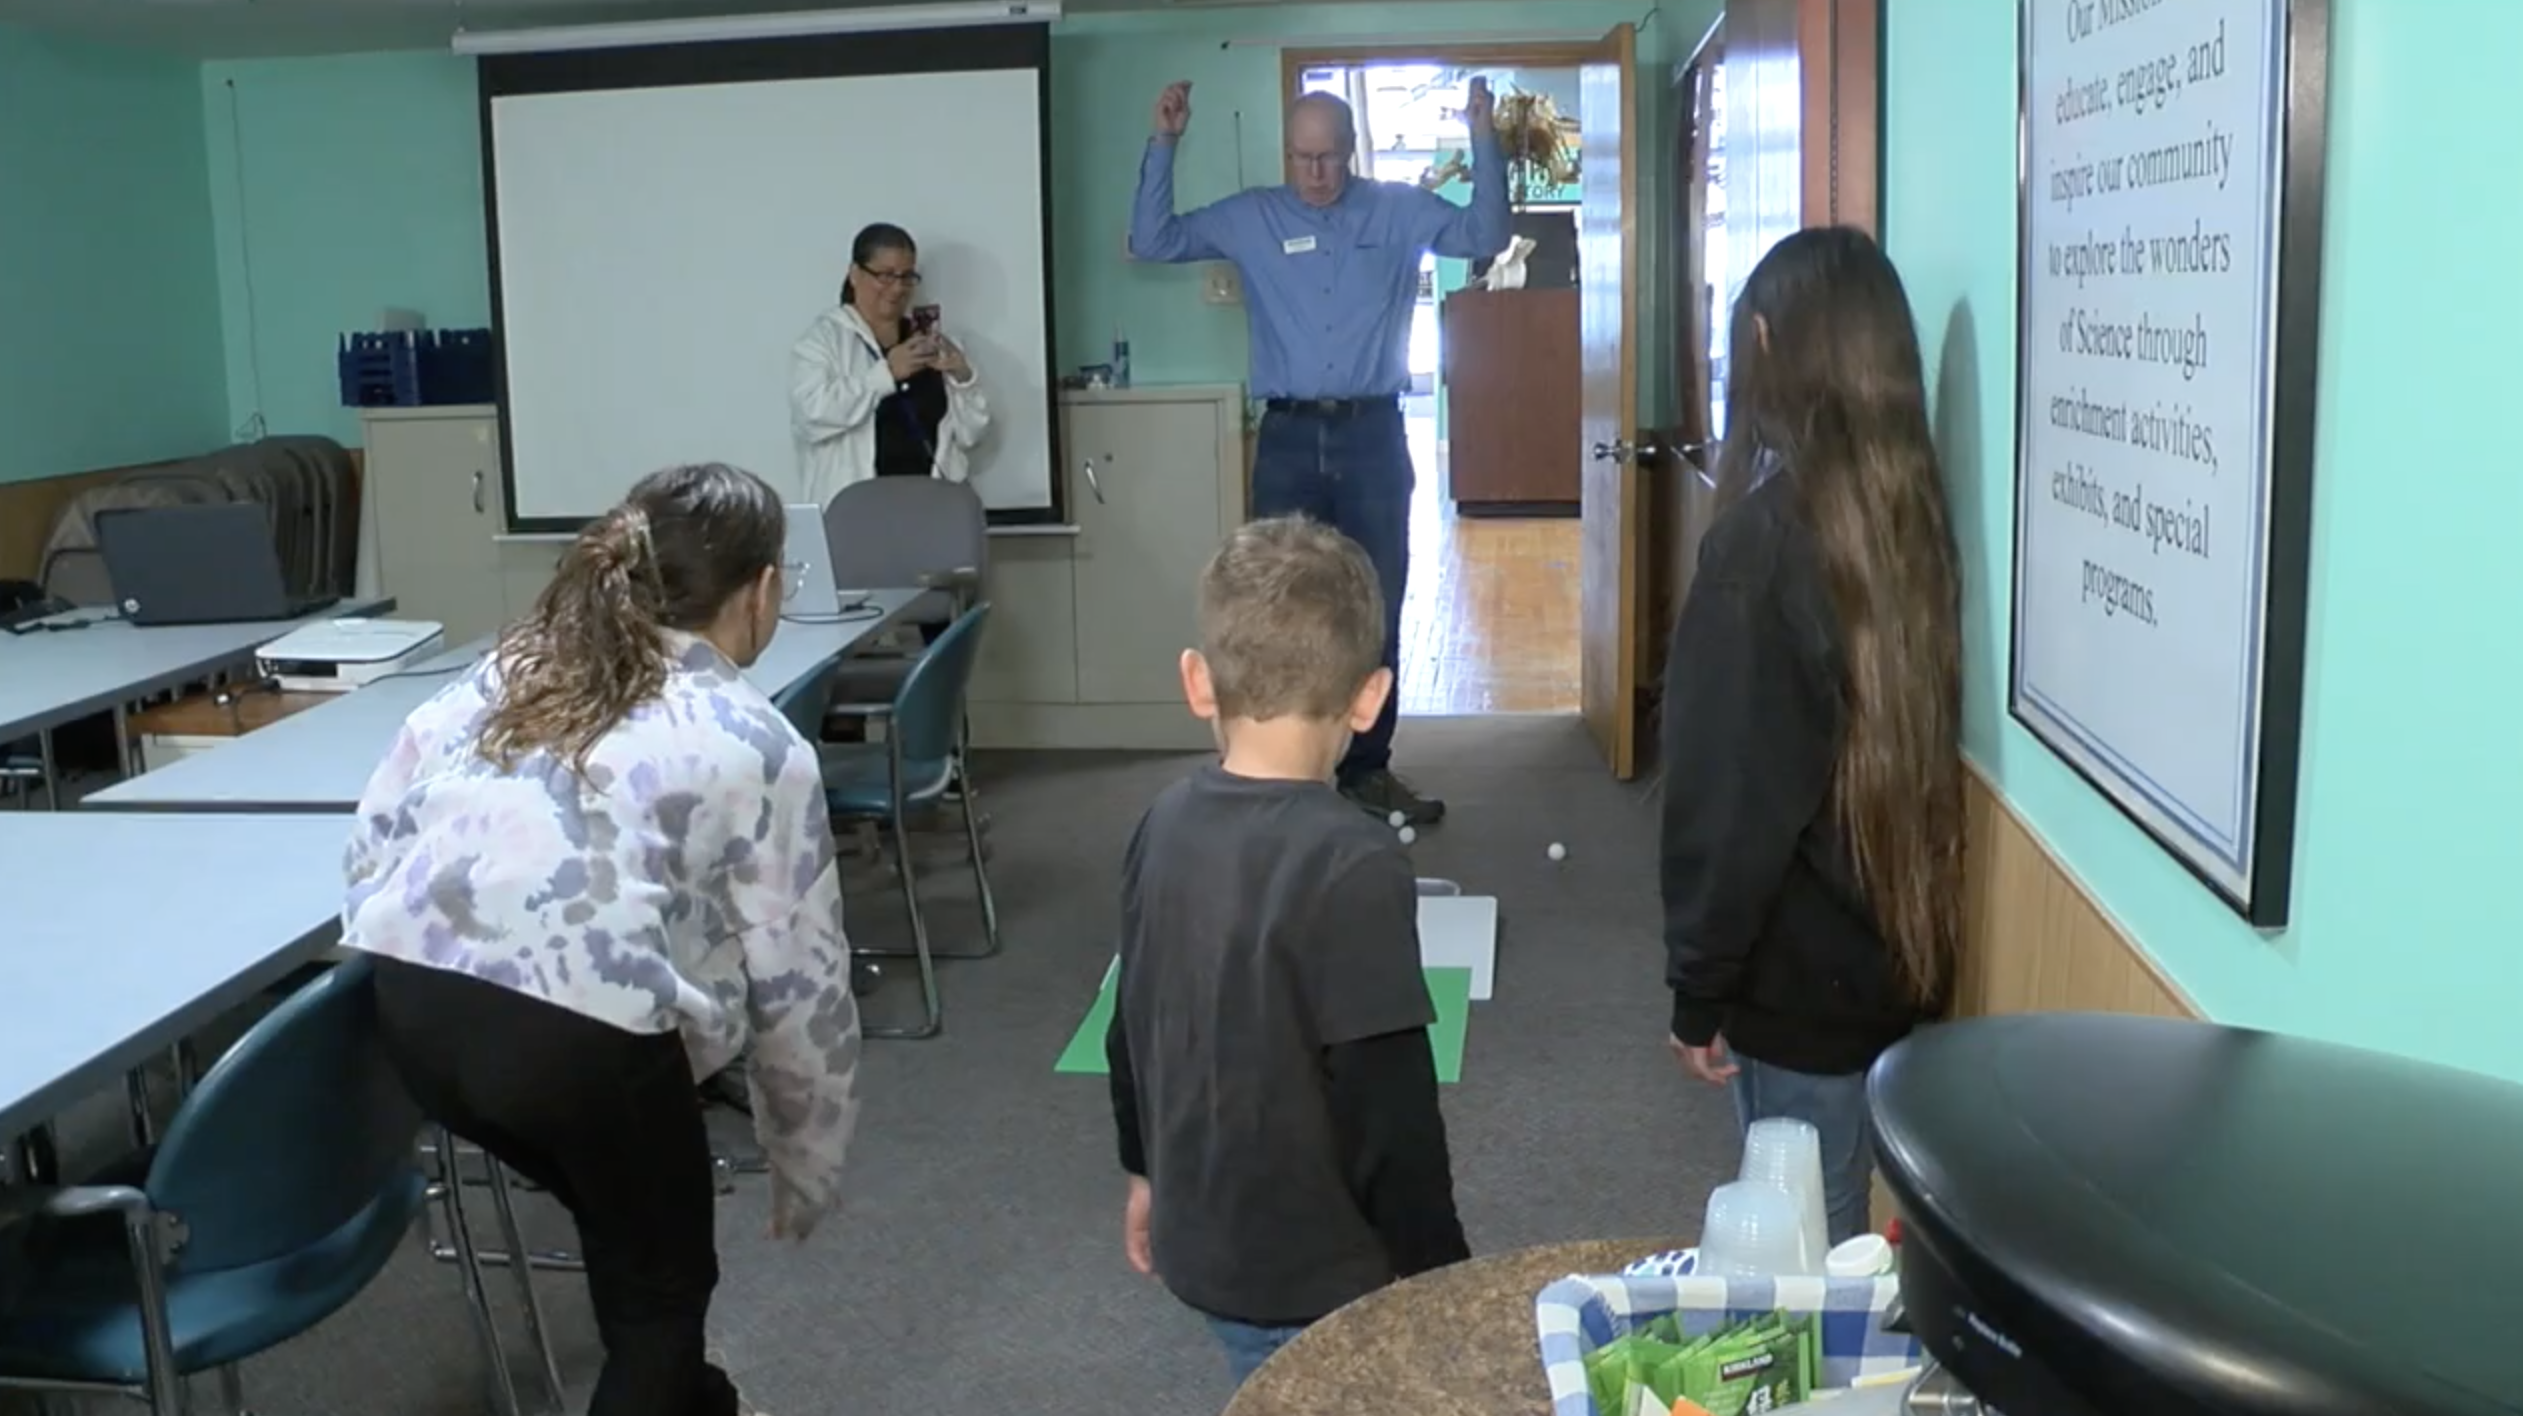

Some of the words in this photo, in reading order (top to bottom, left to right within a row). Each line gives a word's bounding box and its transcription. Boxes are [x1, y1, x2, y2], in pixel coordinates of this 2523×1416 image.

[2067, 0, 2094, 43] Our
[2056, 76, 2112, 125] educate,
[2117, 54, 2181, 115] engage,
[2188, 18, 2225, 84] and
[2050, 152, 2093, 213] inspire
[2097, 158, 2123, 194] our
[2127, 120, 2233, 190] community
[2049, 242, 2061, 277] to
[2064, 229, 2116, 289] explore
[2120, 225, 2145, 275] the
[2150, 217, 2231, 273] wonders
[2059, 307, 2076, 353] of
[2077, 308, 2133, 360] Science
[2137, 311, 2207, 381] through
[2051, 385, 2127, 443] enrichment
[2131, 400, 2219, 477] activities,
[2052, 460, 2109, 528] exhibits,
[2112, 483, 2141, 532] and
[2145, 498, 2209, 559] special
[2082, 559, 2159, 628] programs.
